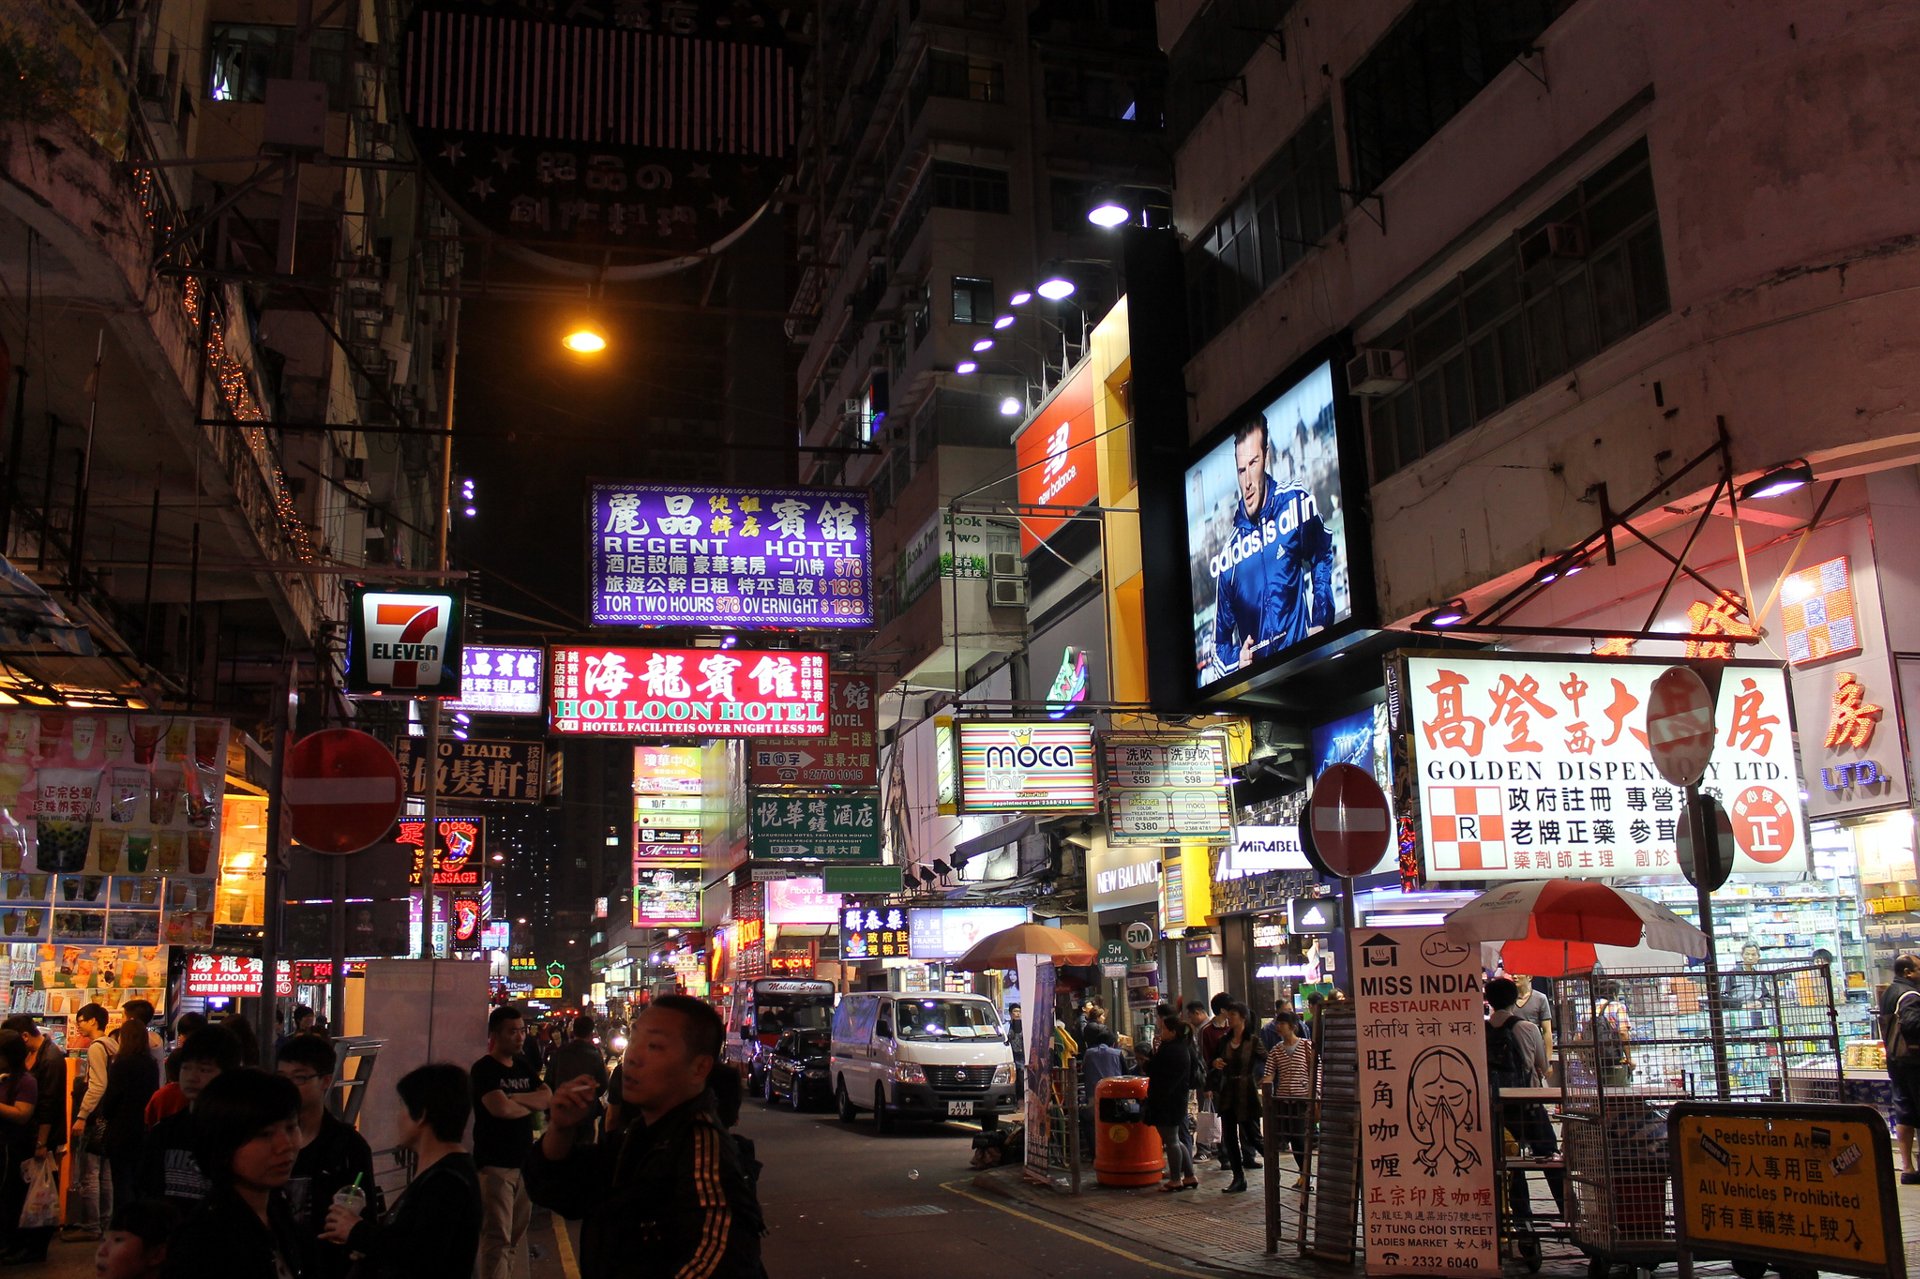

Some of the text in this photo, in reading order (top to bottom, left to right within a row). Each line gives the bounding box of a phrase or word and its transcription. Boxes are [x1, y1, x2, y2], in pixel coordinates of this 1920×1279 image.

[943, 514, 982, 527] Book
[946, 532, 980, 543] Two
[1209, 493, 1317, 579] adidas is all in
[604, 537, 860, 557] REGENT HOTEL
[606, 554, 863, 577] 酒店設備 豪華套房 二小時 $78
[605, 575, 688, 594] 旅遊公幹
[691, 577, 729, 594] 日租
[738, 577, 815, 596] 特平過夜
[604, 595, 631, 612] TOR
[635, 596, 667, 612] TWO
[671, 597, 714, 613] HOURS
[716, 596, 740, 614] $78
[743, 598, 818, 614] OVERNIGHT
[585, 652, 797, 702] 海龍賓館
[555, 700, 617, 719] HOI
[623, 701, 713, 720] LOON
[719, 702, 824, 722] HOTEL
[583, 723, 824, 733] HOTEL FACILITEIS OVER NIGHT LESS 20%
[462, 744, 512, 759] HAIR
[987, 746, 1073, 767] moca
[1126, 748, 1210, 761] 洗吹 洗剪吹
[1428, 760, 1788, 780] GOLDEN DISPENY LTD.
[1820, 760, 1887, 791] LTD.
[987, 771, 1025, 790] hair
[1133, 776, 1150, 784] $58
[1185, 776, 1201, 784] $98
[1508, 787, 1611, 812] 政府註冊
[1134, 822, 1158, 831] $380
[1510, 820, 1616, 846] 老牌正藥
[1747, 815, 1782, 851] 正
[1514, 850, 1615, 869] 藥劑師主理
[432, 872, 477, 885] ASSAGE
[1096, 870, 1117, 894] NEW
[1128, 930, 1149, 942] 5M
[190, 974, 247, 982] HOI LOON
[1361, 974, 1480, 996] MISS INDIA
[1369, 999, 1471, 1014] RESTAURANT
[1363, 1018, 1409, 1038] अतिथि
[1416, 1018, 1442, 1037] देवो
[1715, 1128, 1787, 1147] Pedestrian
[1727, 1154, 1824, 1183] 行人專用區
[1700, 1178, 1861, 1210] All Vehicles Prohibited
[1371, 1225, 1493, 1236] 57 TUNG CHOI STREET
[1701, 1203, 1863, 1246] 所有車輛禁止駛入
[1371, 1238, 1492, 1251] LADIES MARKET 女人街
[1412, 1256, 1478, 1269] 2332 6040
